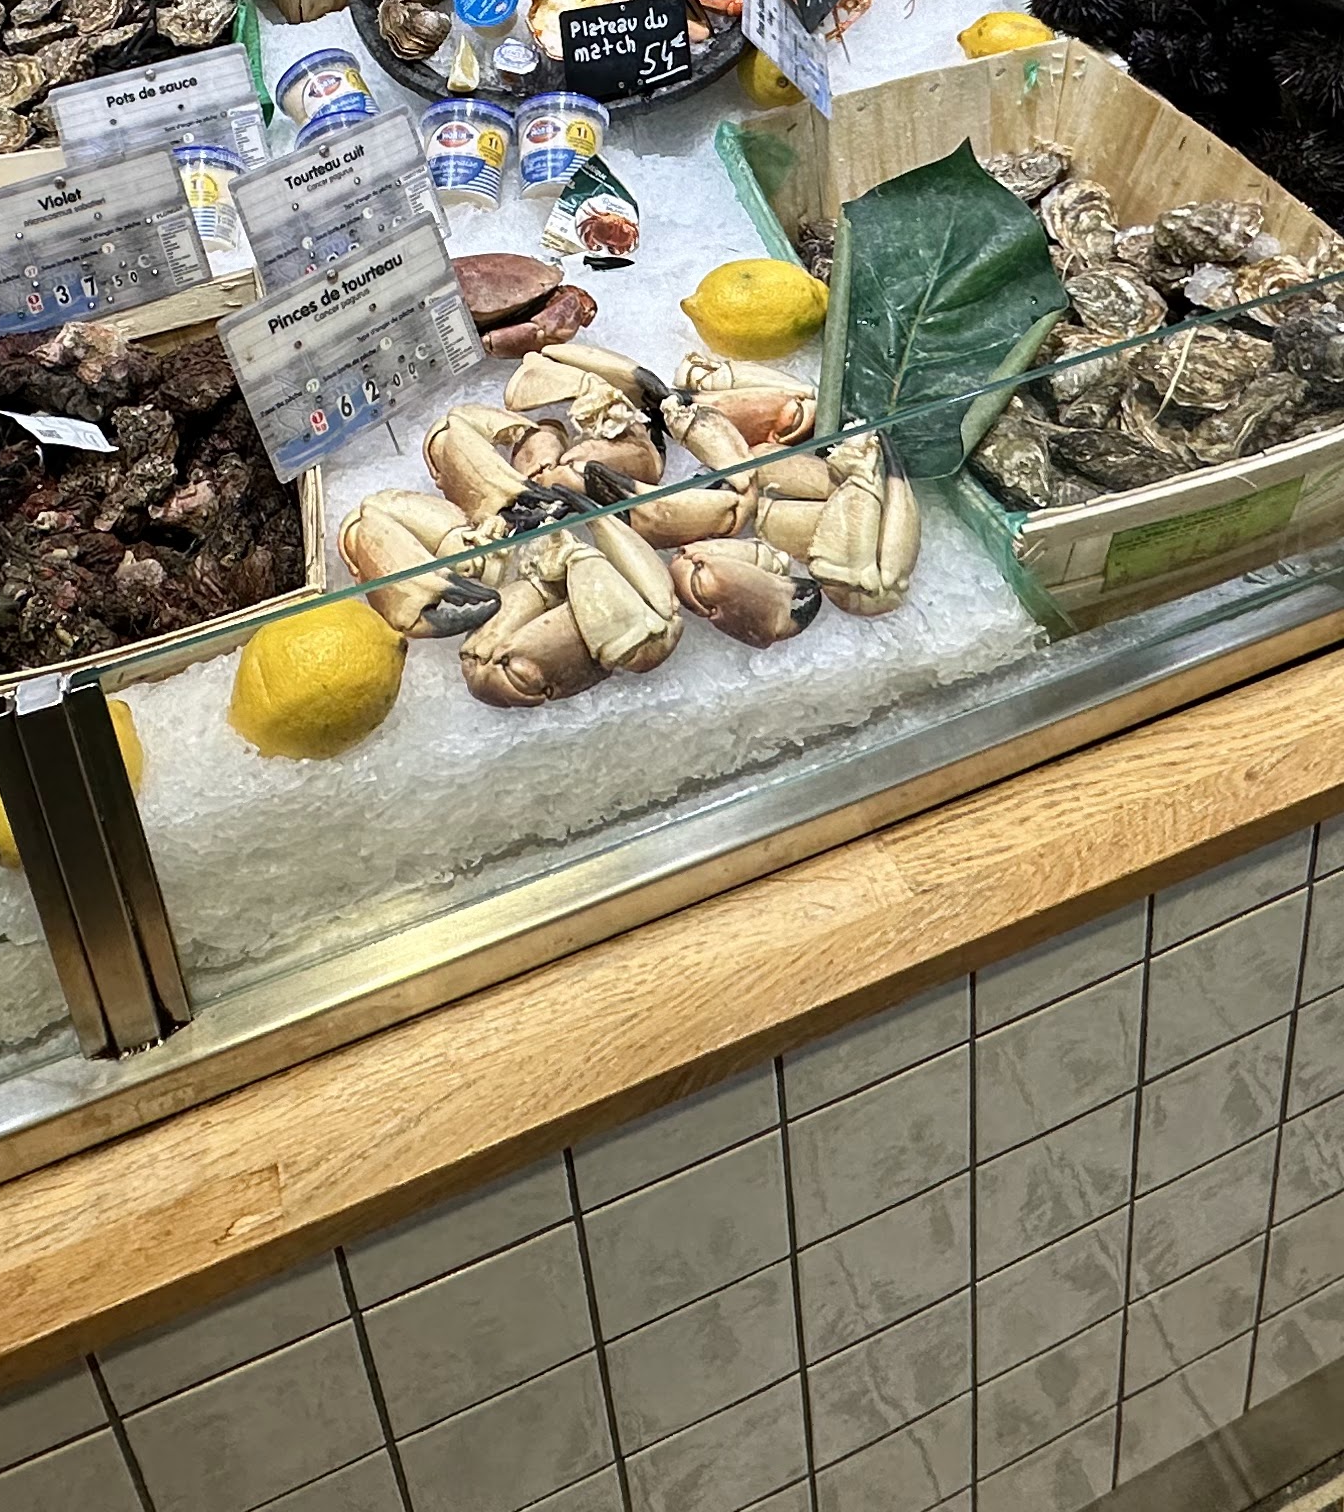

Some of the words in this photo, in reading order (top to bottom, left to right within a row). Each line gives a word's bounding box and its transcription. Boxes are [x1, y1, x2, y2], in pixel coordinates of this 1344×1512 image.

[570, 17, 638, 38] Plateau
[644, 8, 668, 29] du
[574, 37, 637, 62] match
[106, 92, 136, 108] Pots
[138, 84, 156, 101] de
[158, 75, 198, 94] sauce
[284, 157, 341, 190] Tourteau
[343, 144, 365, 166] cuit
[37, 188, 82, 211] Violet
[268, 299, 318, 334] Pinces
[321, 286, 340, 308] de
[342, 253, 403, 295] tourteau
